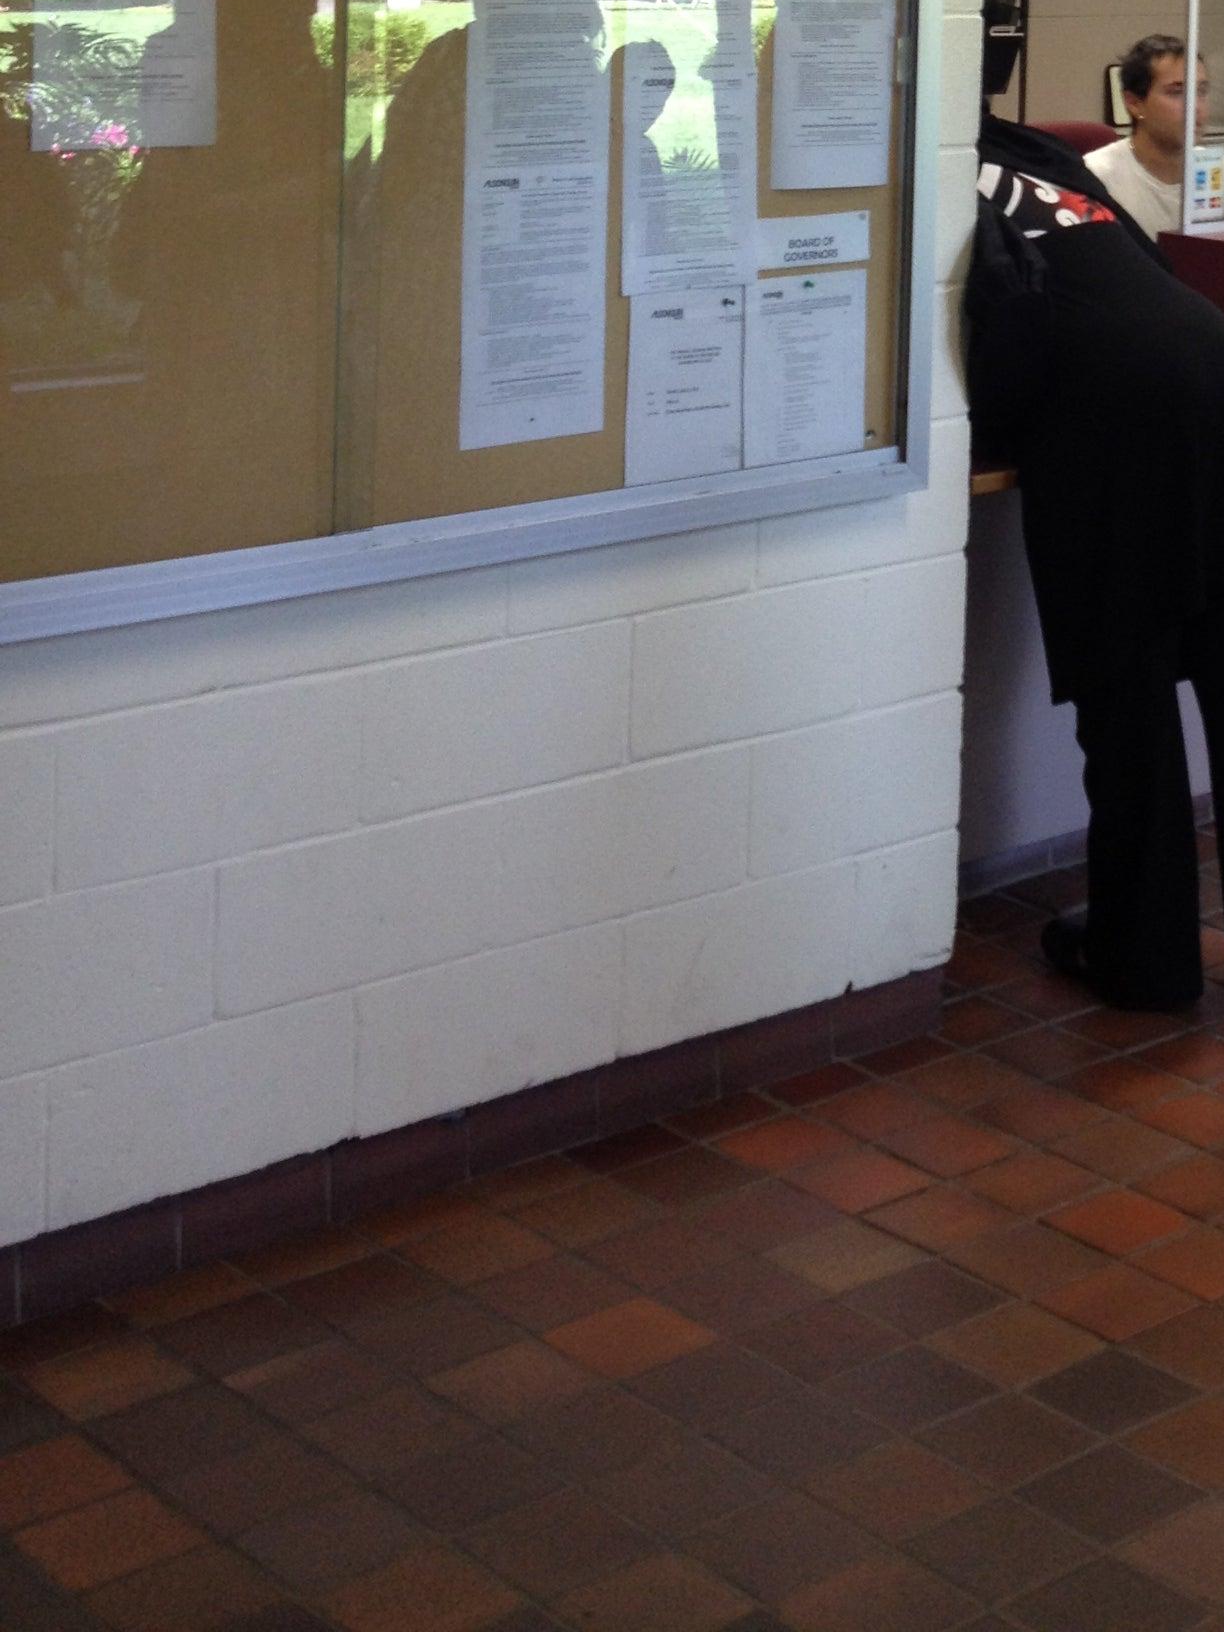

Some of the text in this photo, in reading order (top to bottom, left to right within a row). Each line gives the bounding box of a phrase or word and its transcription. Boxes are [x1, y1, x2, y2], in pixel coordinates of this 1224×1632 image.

[788, 235, 835, 249] BOARD OF
[783, 249, 838, 262] GOVERNORS
